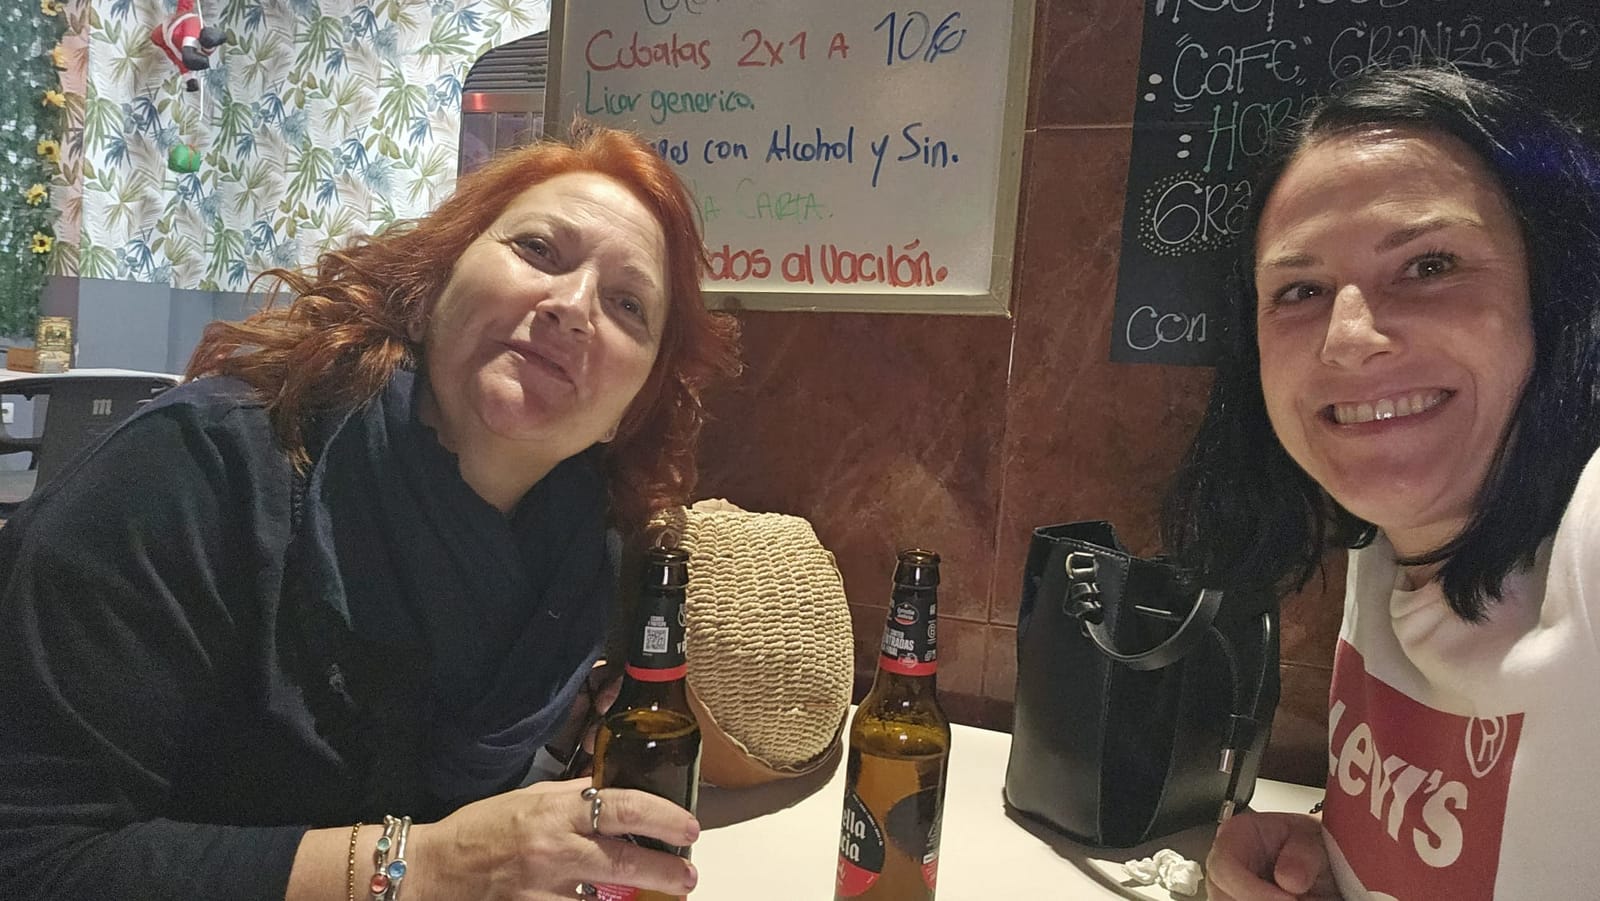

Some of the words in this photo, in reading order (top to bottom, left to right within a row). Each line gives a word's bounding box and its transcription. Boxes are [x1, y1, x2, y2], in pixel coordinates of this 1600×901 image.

[585, 29, 711, 71] Cubatas
[736, 28, 808, 67] 2x1
[828, 32, 850, 59] A
[585, 71, 642, 115] Licor
[703, 138, 749, 165] con
[765, 124, 854, 163] Alcohol
[871, 134, 889, 188] y
[897, 122, 960, 168] Sin.
[704, 244, 772, 282] dos
[781, 244, 815, 285] al
